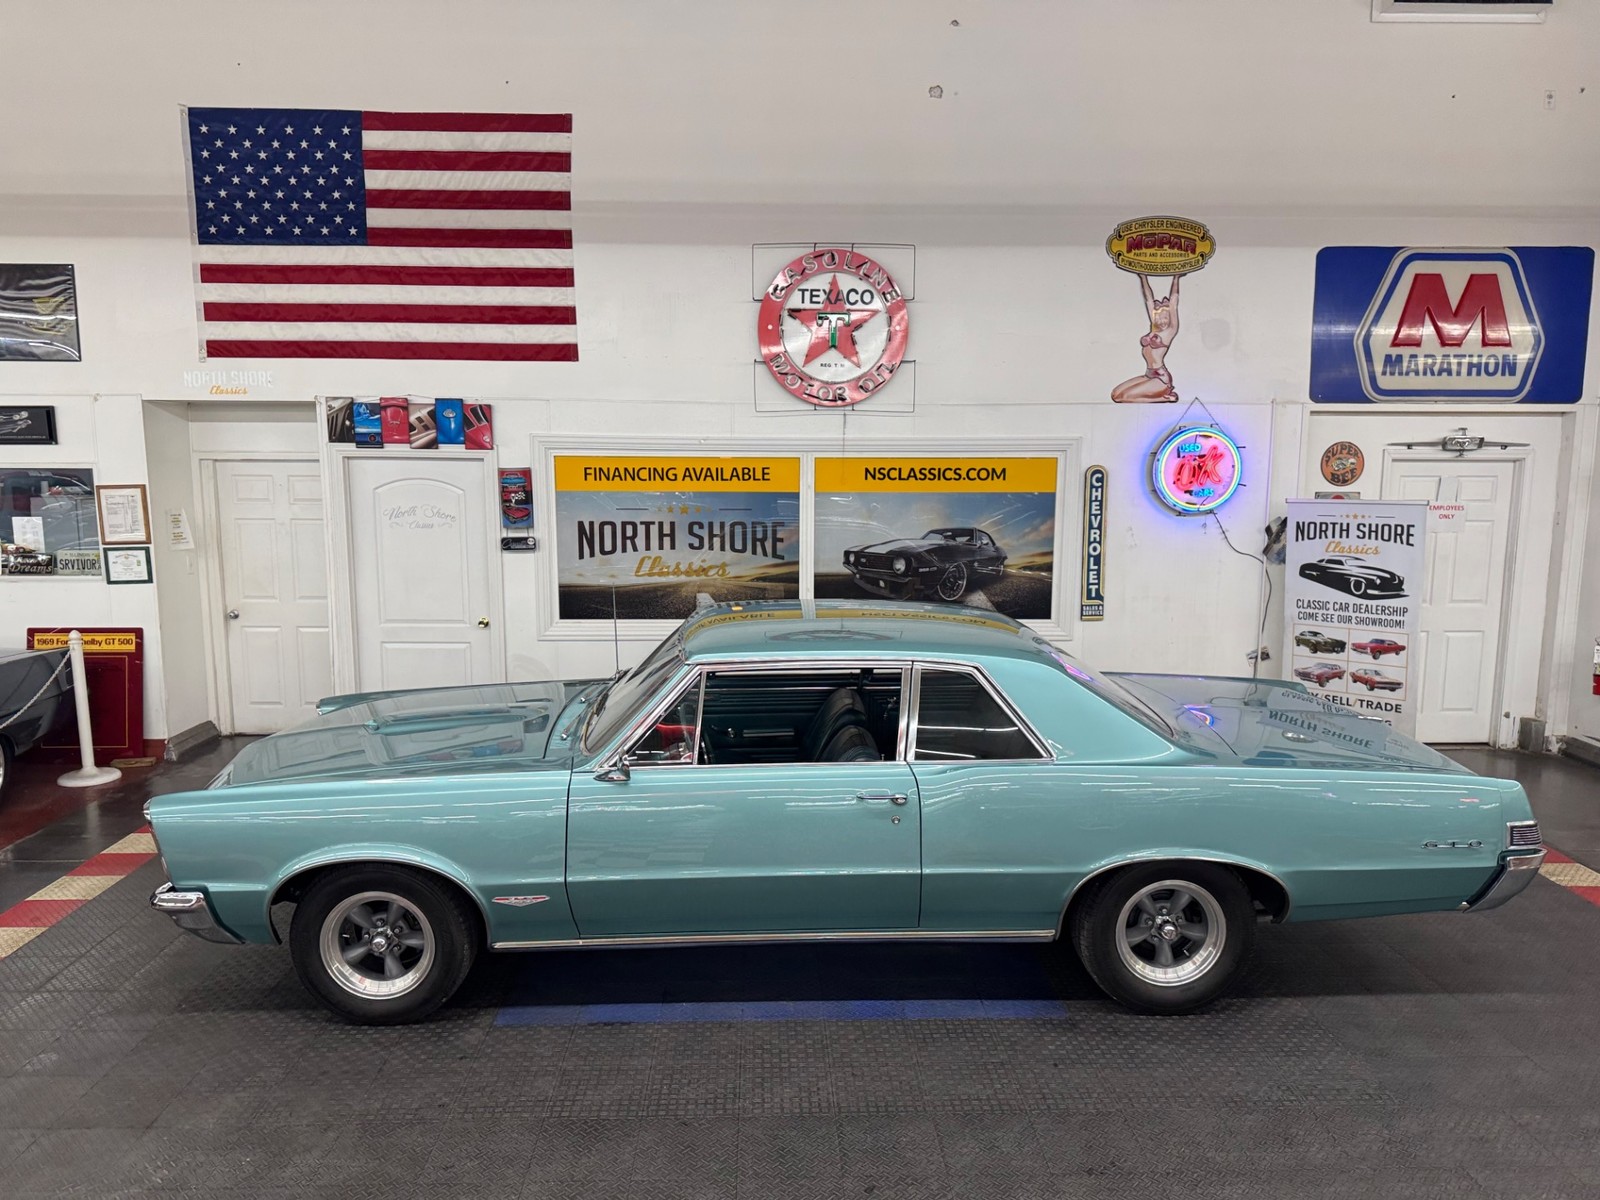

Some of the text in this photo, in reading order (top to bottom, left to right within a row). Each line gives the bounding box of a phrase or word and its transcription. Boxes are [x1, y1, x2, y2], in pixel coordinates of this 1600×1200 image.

[1121, 219, 1202, 235] USE CHRYSLER ENGINEERED
[770, 250, 903, 304] GASOLINE
[797, 287, 875, 306] TEXACO
[1389, 273, 1512, 348] M
[1381, 354, 1517, 377] MARATHON
[183, 370, 274, 388] NORTH SHORE
[769, 353, 898, 403] MOTOR OIL
[209, 384, 248, 395] Classics
[1179, 443, 1202, 453] USED
[1323, 441, 1361, 468] SUPER
[583, 466, 771, 482] FINANCING AVAILABLE
[864, 466, 1007, 482] NSCLASSICS.COM
[1330, 467, 1359, 485] BEE
[382, 503, 457, 522] North Shore
[577, 520, 785, 560] NORTH SHORE
[1088, 473, 1103, 598] CHEVROLET
[1295, 520, 1416, 547] NORTH SHORE
[1325, 540, 1381, 556] Classics
[10, 563, 52, 573] Dreams
[59, 558, 97, 571] SRVIVOR
[634, 555, 731, 578] Classics
[1296, 598, 1409, 618] CLASSIC CAR DEALERSHIP
[1297, 611, 1405, 630] COME SEE OUR SHOWROOM!
[36, 637, 134, 647] 1969 For helby GT 500
